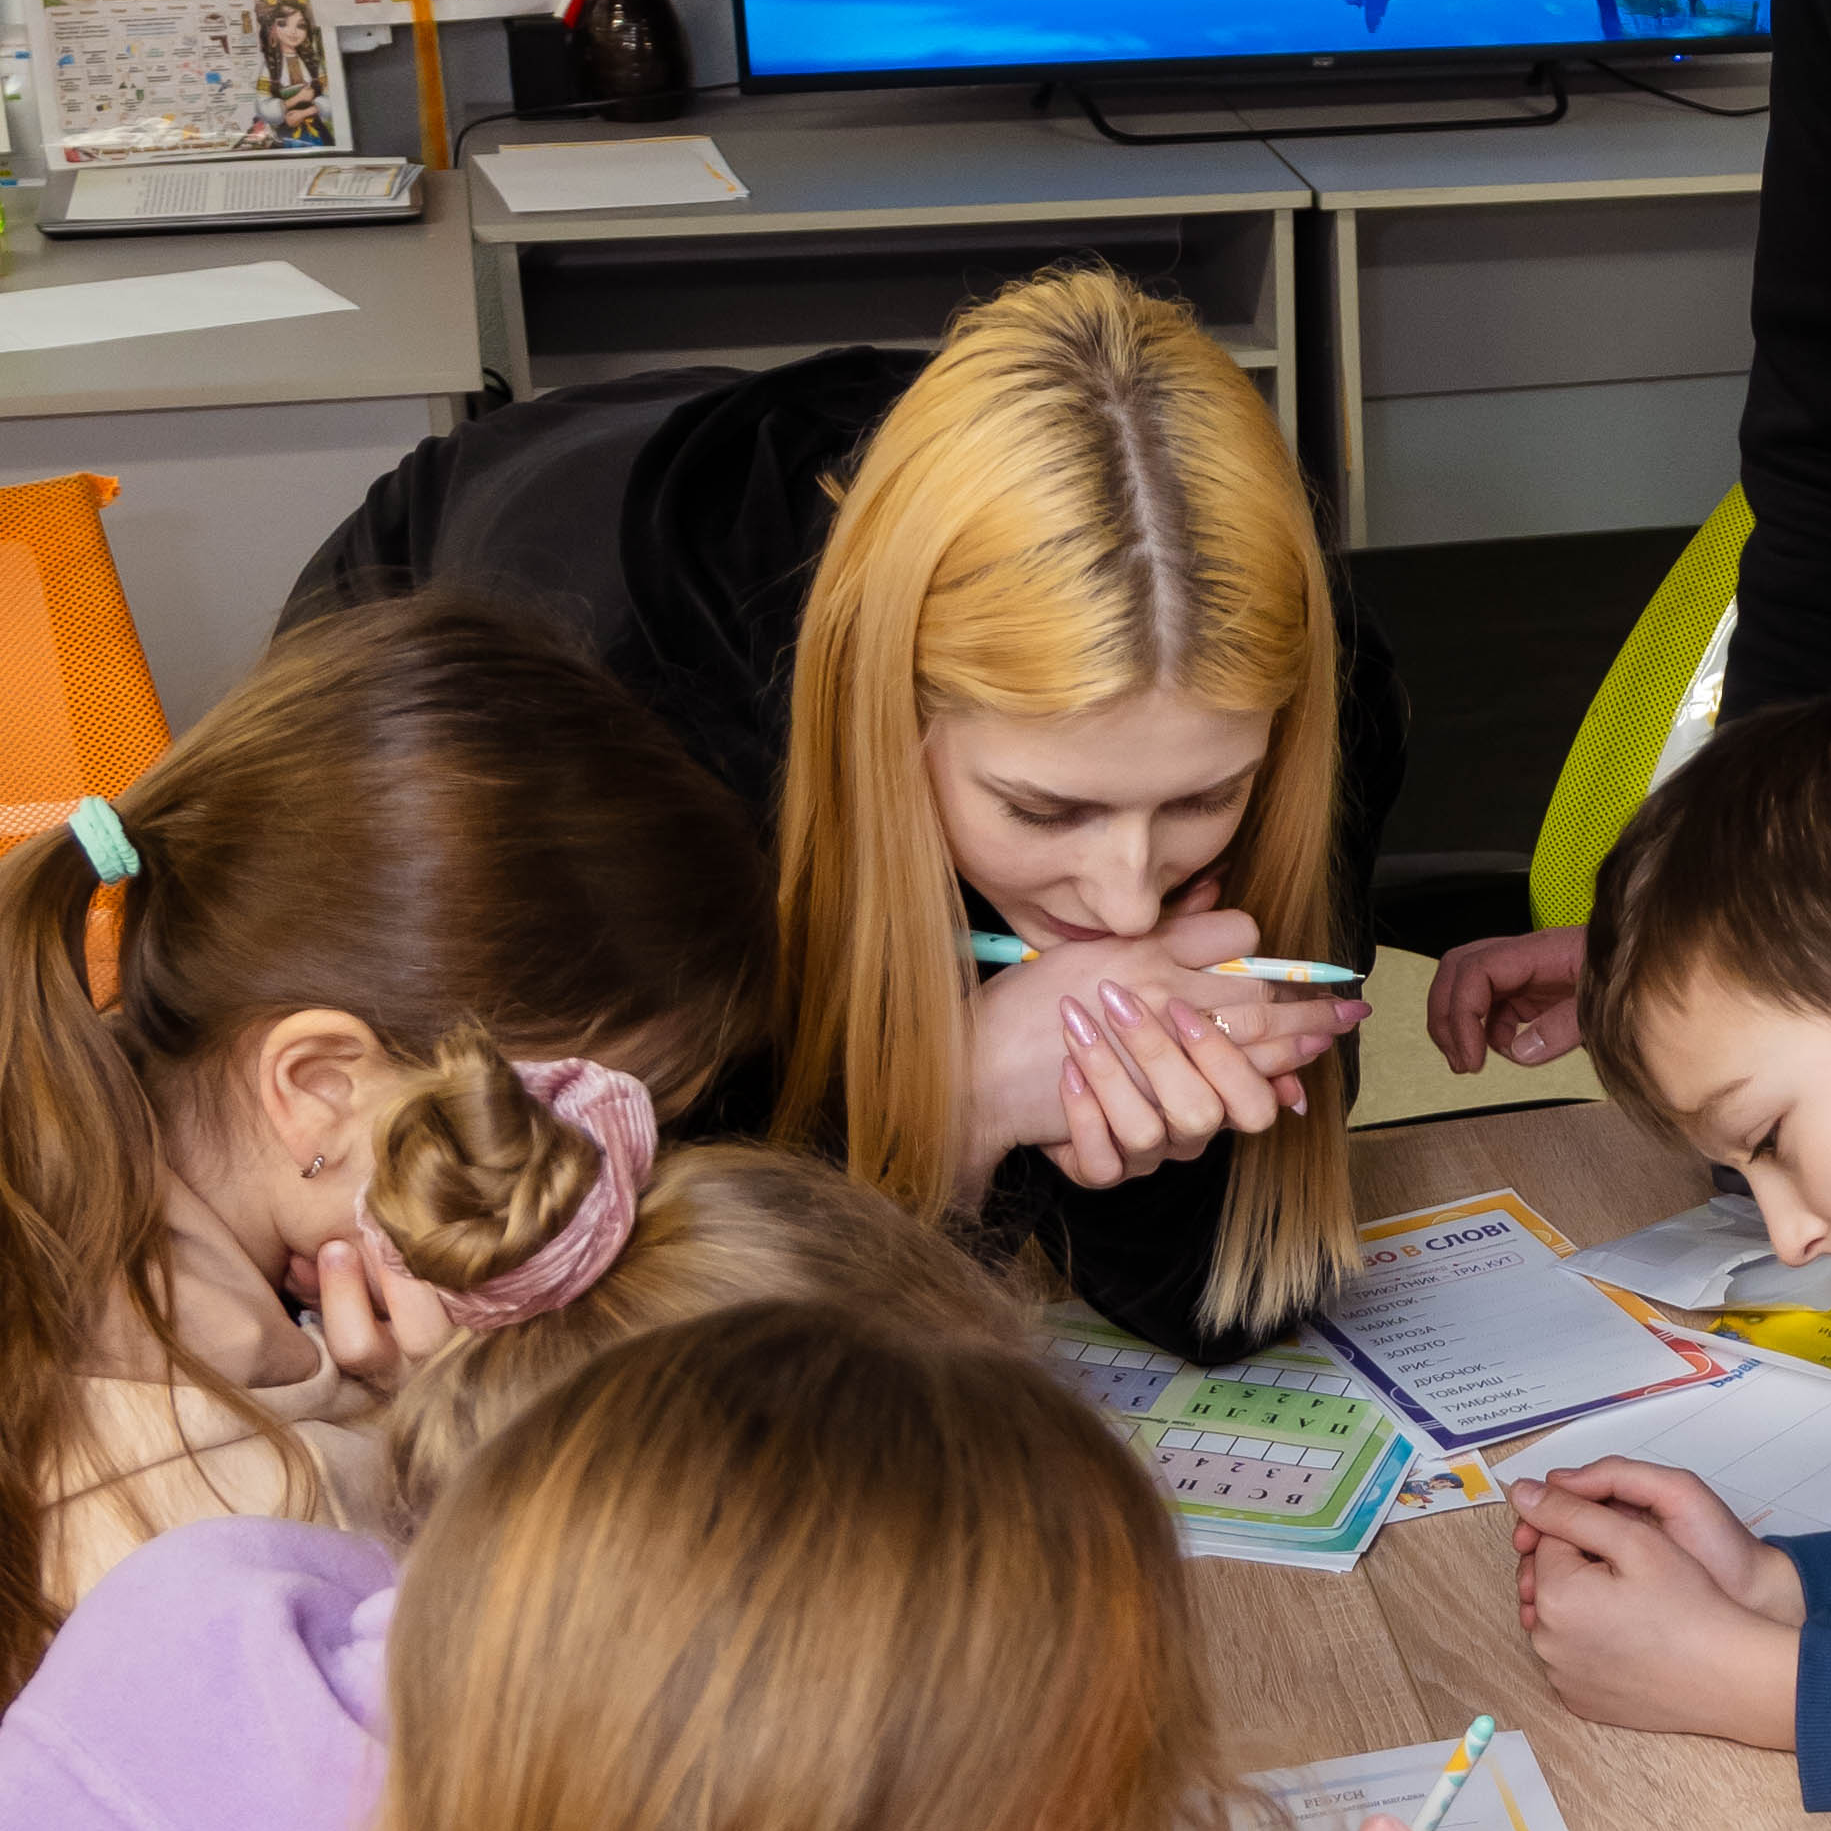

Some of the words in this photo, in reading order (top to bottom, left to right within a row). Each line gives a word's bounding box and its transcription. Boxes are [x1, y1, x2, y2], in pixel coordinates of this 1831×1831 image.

[1425, 1222, 1511, 1251] СЛОВІ
[1486, 1255, 1514, 1271] КУТ
[1355, 1315, 1409, 1334] ЧАЙКА
[1369, 1325, 1438, 1347] ЗАГРОЗА
[1383, 1339, 1446, 1359] ЗОЛОТО
[1398, 1358, 1437, 1375] ІРИС
[1413, 1363, 1488, 1388] ДУБОЧОК
[1426, 1375, 1504, 1400] ТОВАРИШ
[1441, 1386, 1529, 1413] ТУМБОЧКА
[1457, 1402, 1534, 1427] ЯРМАРОК
